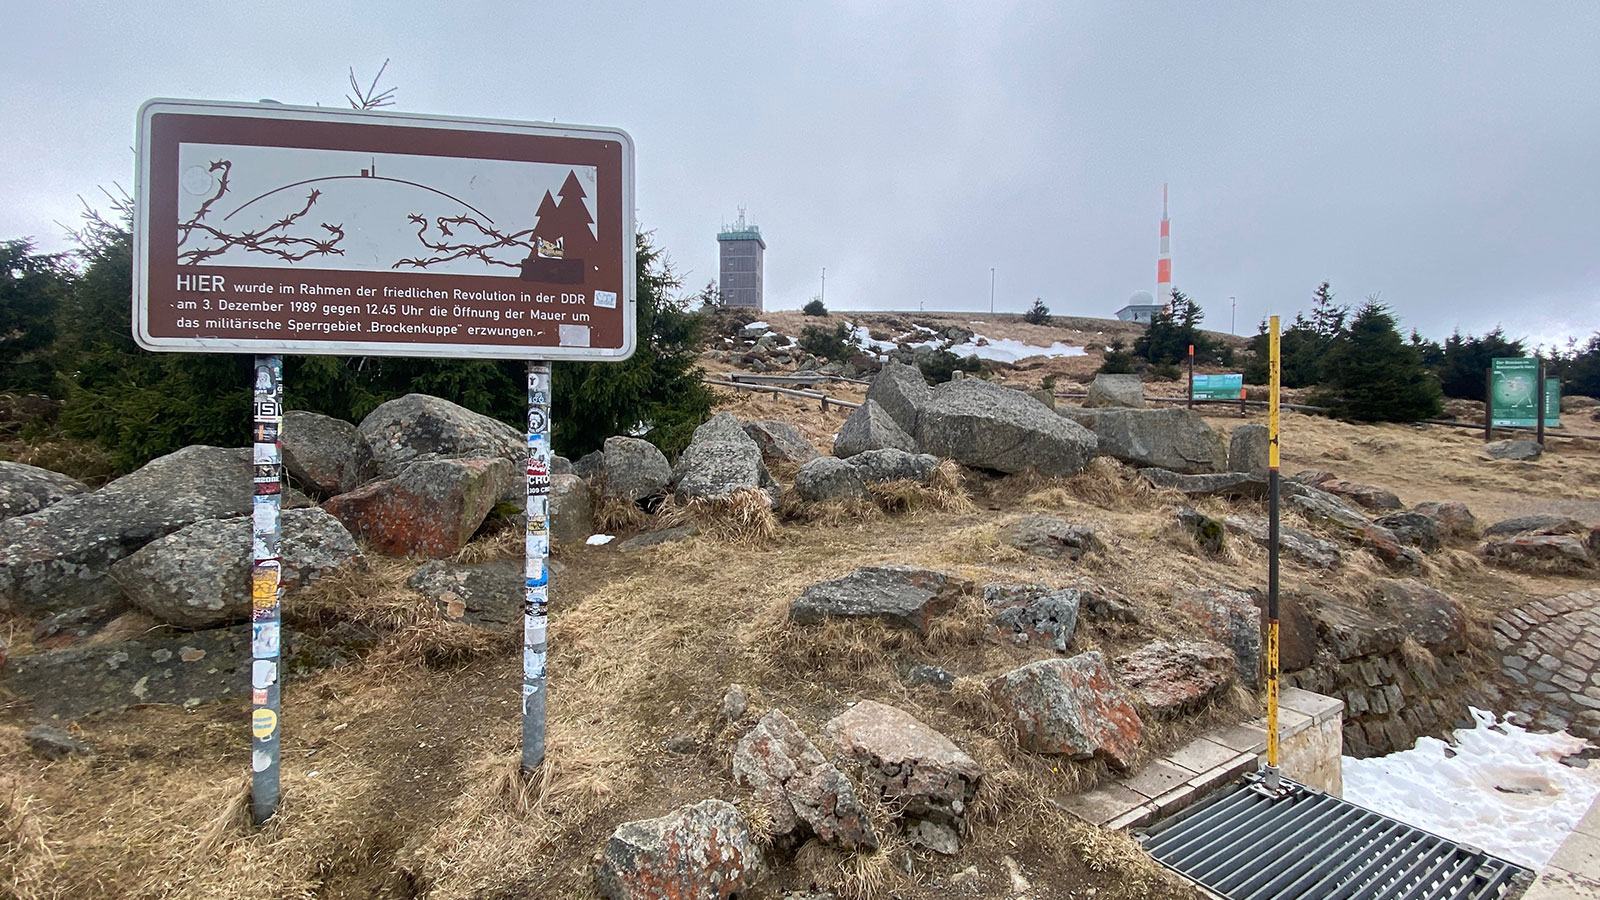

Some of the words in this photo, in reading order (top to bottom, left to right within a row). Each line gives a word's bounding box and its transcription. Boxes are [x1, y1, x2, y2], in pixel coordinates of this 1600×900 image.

[176, 274, 226, 292] HIER
[233, 282, 274, 294] wurde
[279, 282, 295, 295] im
[299, 283, 351, 296] Rahmen
[356, 285, 378, 297] der
[383, 286, 449, 300] friedlichen
[453, 288, 516, 302] Revolution
[520, 291, 531, 302] in
[535, 292, 556, 304] der
[560, 293, 586, 305] DDR
[176, 300, 197, 310] am
[202, 298, 213, 310] 3.
[218, 299, 284, 312] Dezember
[290, 301, 318, 313] 1989
[322, 304, 361, 316] gegen
[365, 303, 397, 315] 12.45
[401, 304, 424, 316] Uhr
[429, 305, 448, 317] die
[452, 304, 500, 321] Öffnung
[504, 308, 525, 319] der
[530, 309, 567, 321] Mauer
[572, 313, 590, 322] um
[176, 316, 200, 328] das
[205, 317, 282, 330] militärische
[287, 319, 362, 334] Sperrgebiet
[467, 326, 537, 339] erzwungen.
